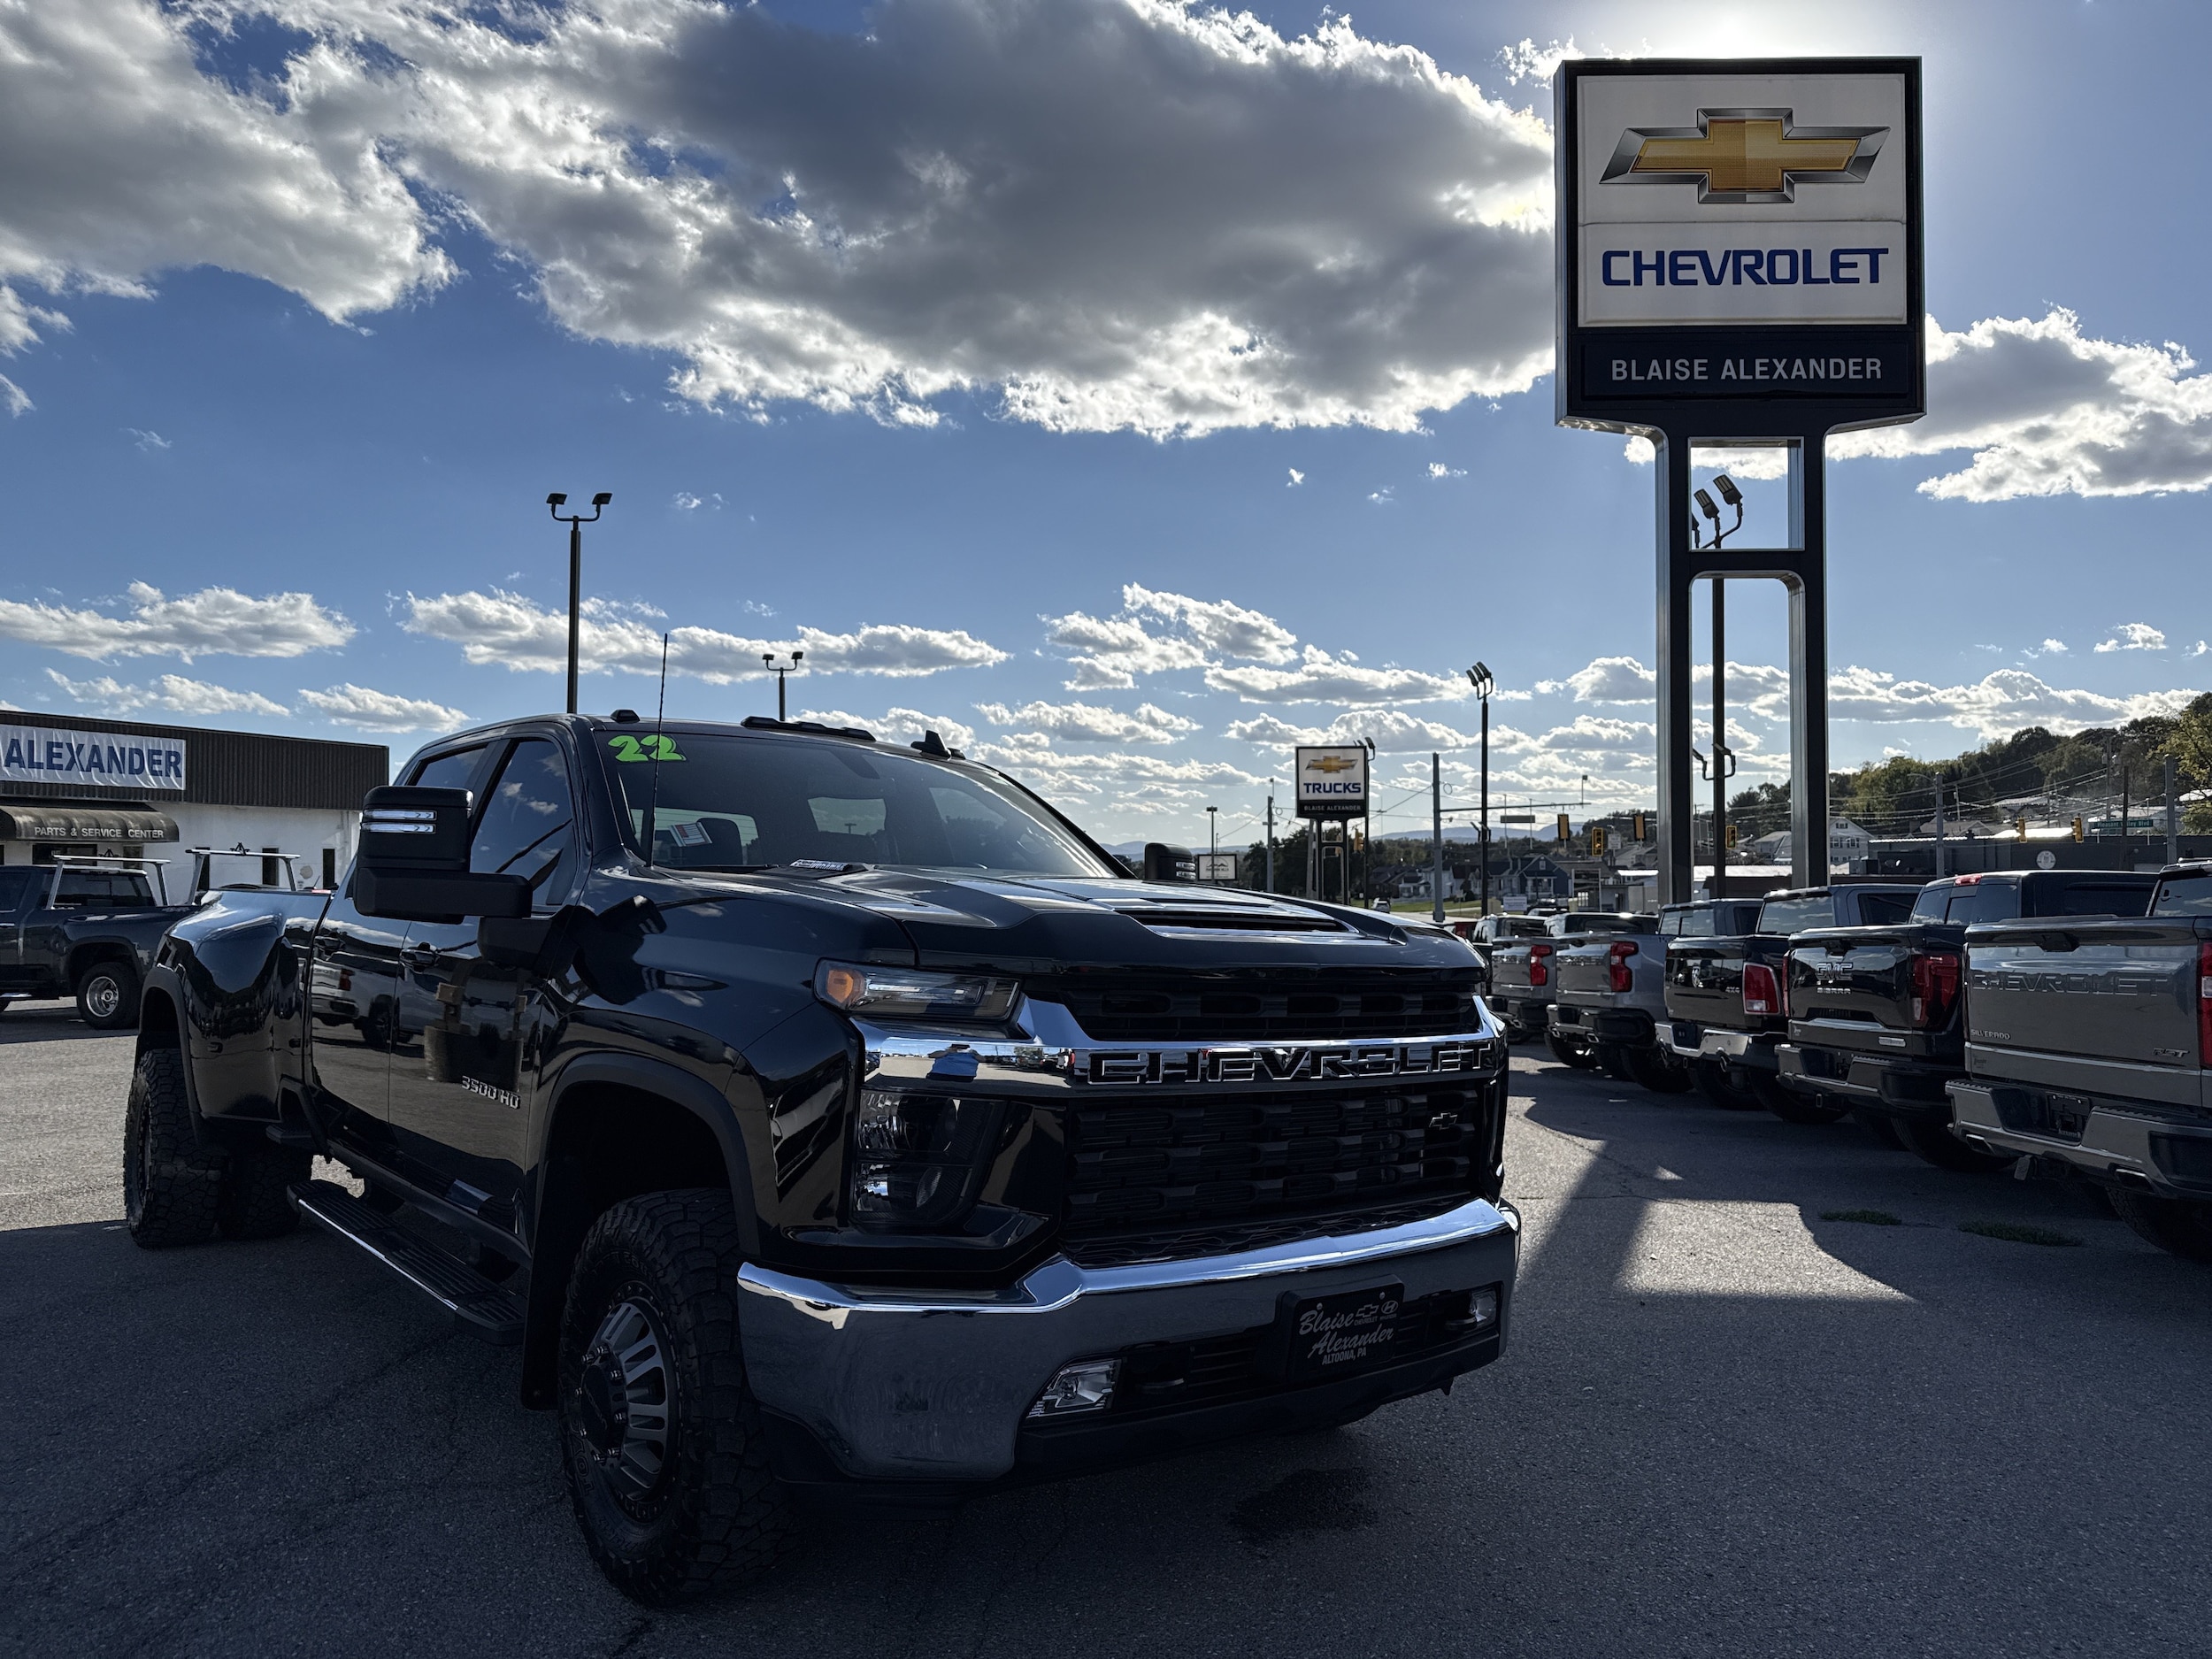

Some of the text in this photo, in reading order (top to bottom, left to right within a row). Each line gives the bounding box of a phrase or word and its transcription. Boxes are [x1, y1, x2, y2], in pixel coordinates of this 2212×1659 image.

[1602, 248, 1889, 286] CHEVROLET
[1611, 357, 1882, 381] BLAISE ALEXANDER
[4, 738, 182, 779] ALEXANDER
[608, 734, 687, 763] 22
[1303, 782, 1362, 794] TRUCKS
[35, 827, 165, 839] PARTS & SERVICE CENTER
[1816, 962, 1854, 981] GMC
[1971, 973, 2168, 997] CHEVROLET
[1970, 1028, 2012, 1041] SILVERADO
[1087, 1041, 1494, 1085] CHEVROLET
[2152, 1047, 2190, 1058] RST
[461, 1075, 521, 1110] 3500 HD
[1299, 1310, 1355, 1335] Blaise
[1307, 1324, 1394, 1359] Alexander
[1321, 1347, 1367, 1365] ALTOONA, PA
